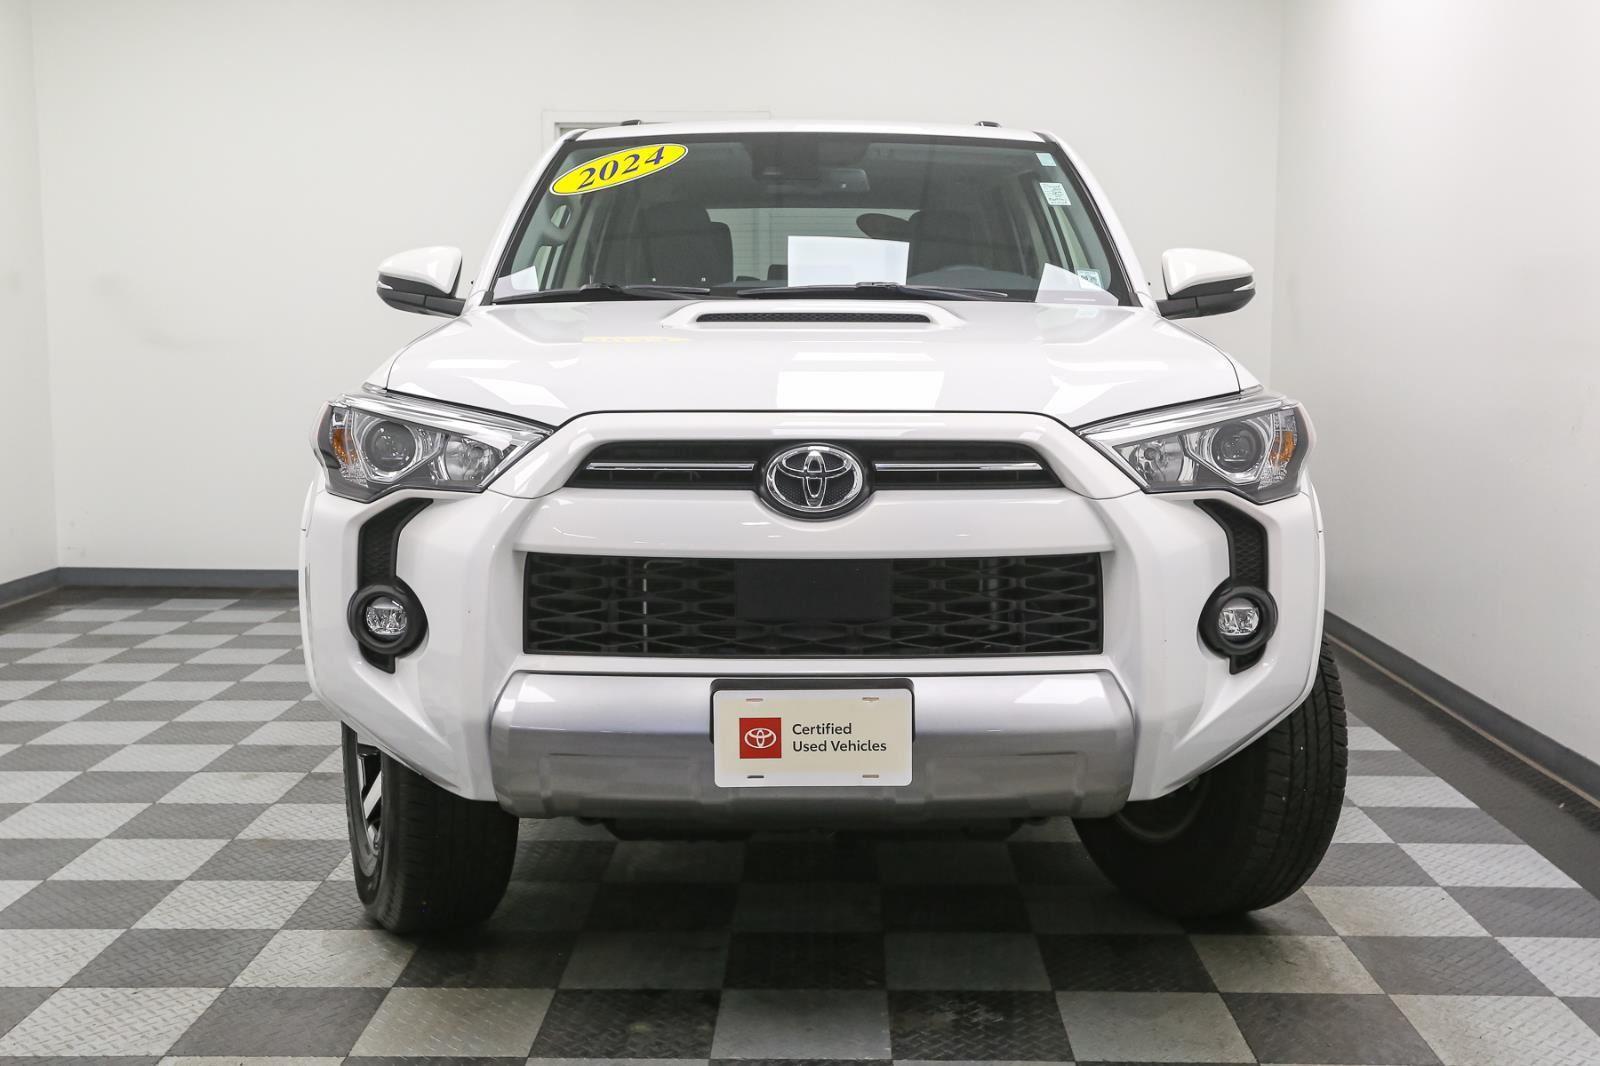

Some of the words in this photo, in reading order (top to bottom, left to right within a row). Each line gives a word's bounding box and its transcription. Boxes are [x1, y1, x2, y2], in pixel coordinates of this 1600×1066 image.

[576, 146, 665, 190] 2024
[792, 722, 852, 735] Certified
[792, 739, 827, 752] Used
[830, 739, 887, 752] Vehicles
